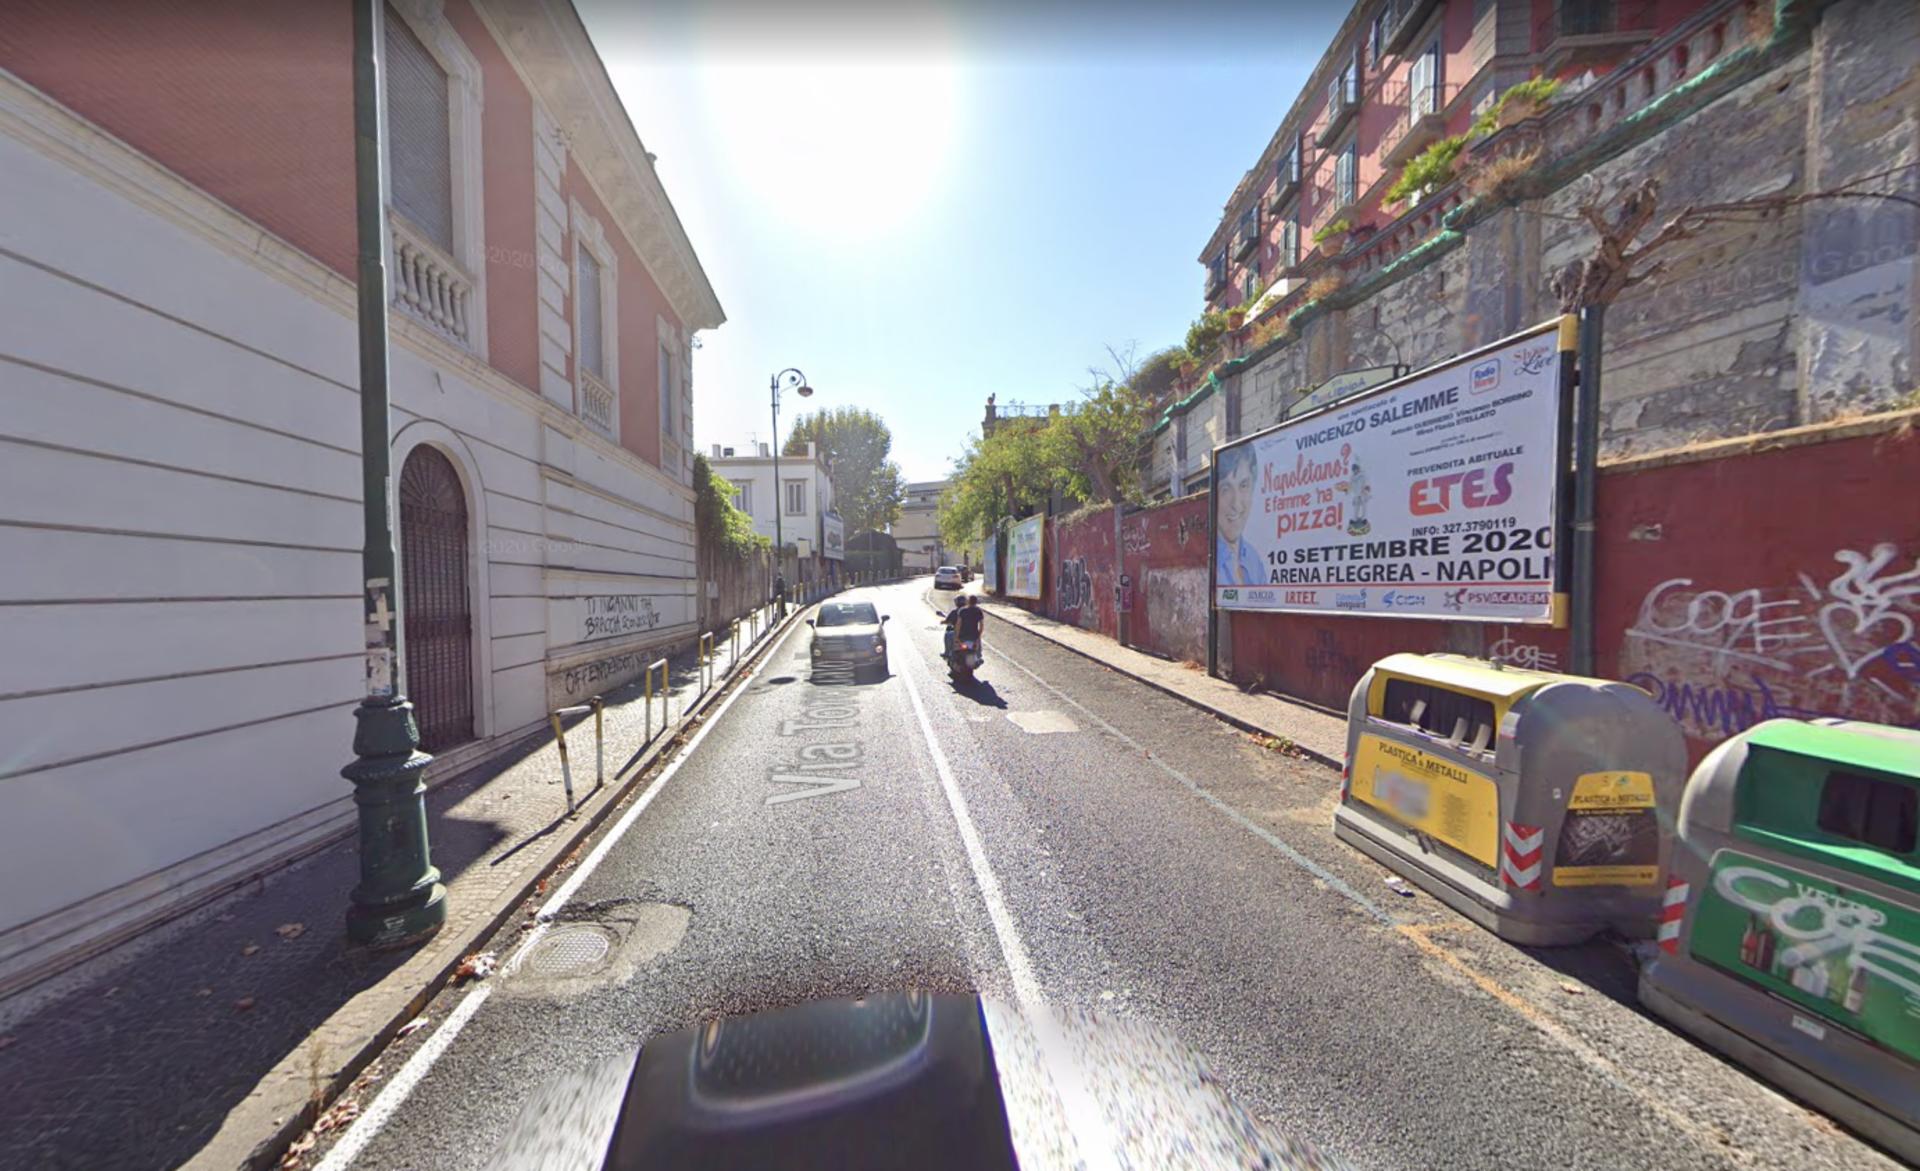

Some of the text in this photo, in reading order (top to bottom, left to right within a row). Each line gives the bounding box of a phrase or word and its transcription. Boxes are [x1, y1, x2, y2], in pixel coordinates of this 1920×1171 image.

[1296, 418, 1366, 451] VINCENZO
[1369, 386, 1460, 429] SALEMME
[1261, 443, 1351, 494] Napoletano?
[1407, 445, 1525, 477] PREVENDITA ABITUALE
[1272, 493, 1312, 512] famme
[1409, 462, 1515, 516] ETES
[1277, 502, 1344, 539] pizza!
[1412, 526, 1440, 537] INFO:
[1267, 526, 1552, 566] 10 SETTEMBRE 2020
[1270, 567, 1321, 584] ARENA
[1326, 562, 1415, 583] FLEGREA
[1437, 555, 1551, 582] NAPOLI
[1378, 741, 1418, 766] PLASTICA
[1425, 759, 1468, 784] METALLI
